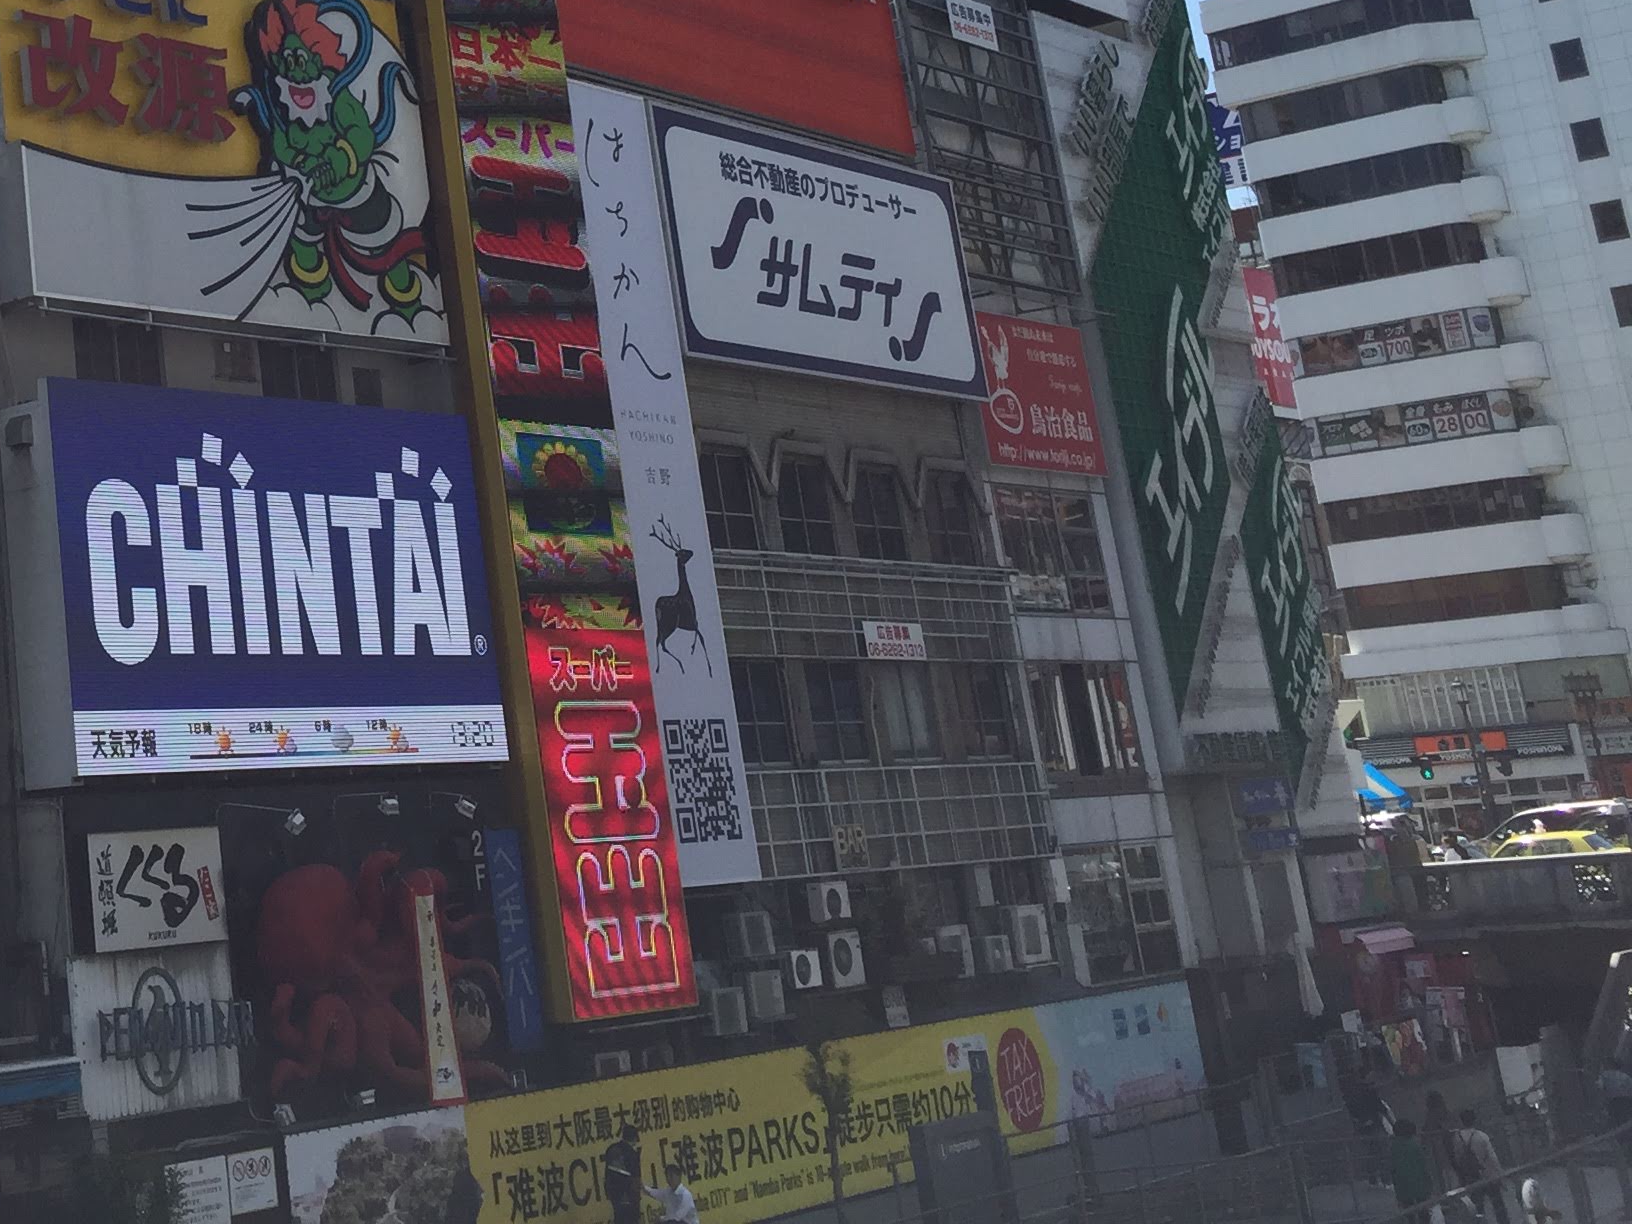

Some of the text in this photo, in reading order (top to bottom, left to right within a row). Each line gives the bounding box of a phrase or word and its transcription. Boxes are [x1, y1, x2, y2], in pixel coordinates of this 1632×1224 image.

[15, 10, 237, 143] 改源
[718, 150, 918, 220] 総合不動産のプロデューサー
[756, 235, 903, 328] サムティ
[629, 430, 674, 445] YOSHINO
[86, 444, 473, 666] CHINTAI
[548, 643, 634, 692] スーパー
[90, 728, 159, 759] 天気予報
[838, 826, 866, 856] BAR
[117, 843, 200, 928] くくる
[98, 1000, 205, 1062] PENUIN
[1000, 1034, 1034, 1085] TAX
[838, 1080, 978, 1148] 徒步只需约10分
[1004, 1070, 1045, 1124] FREE!
